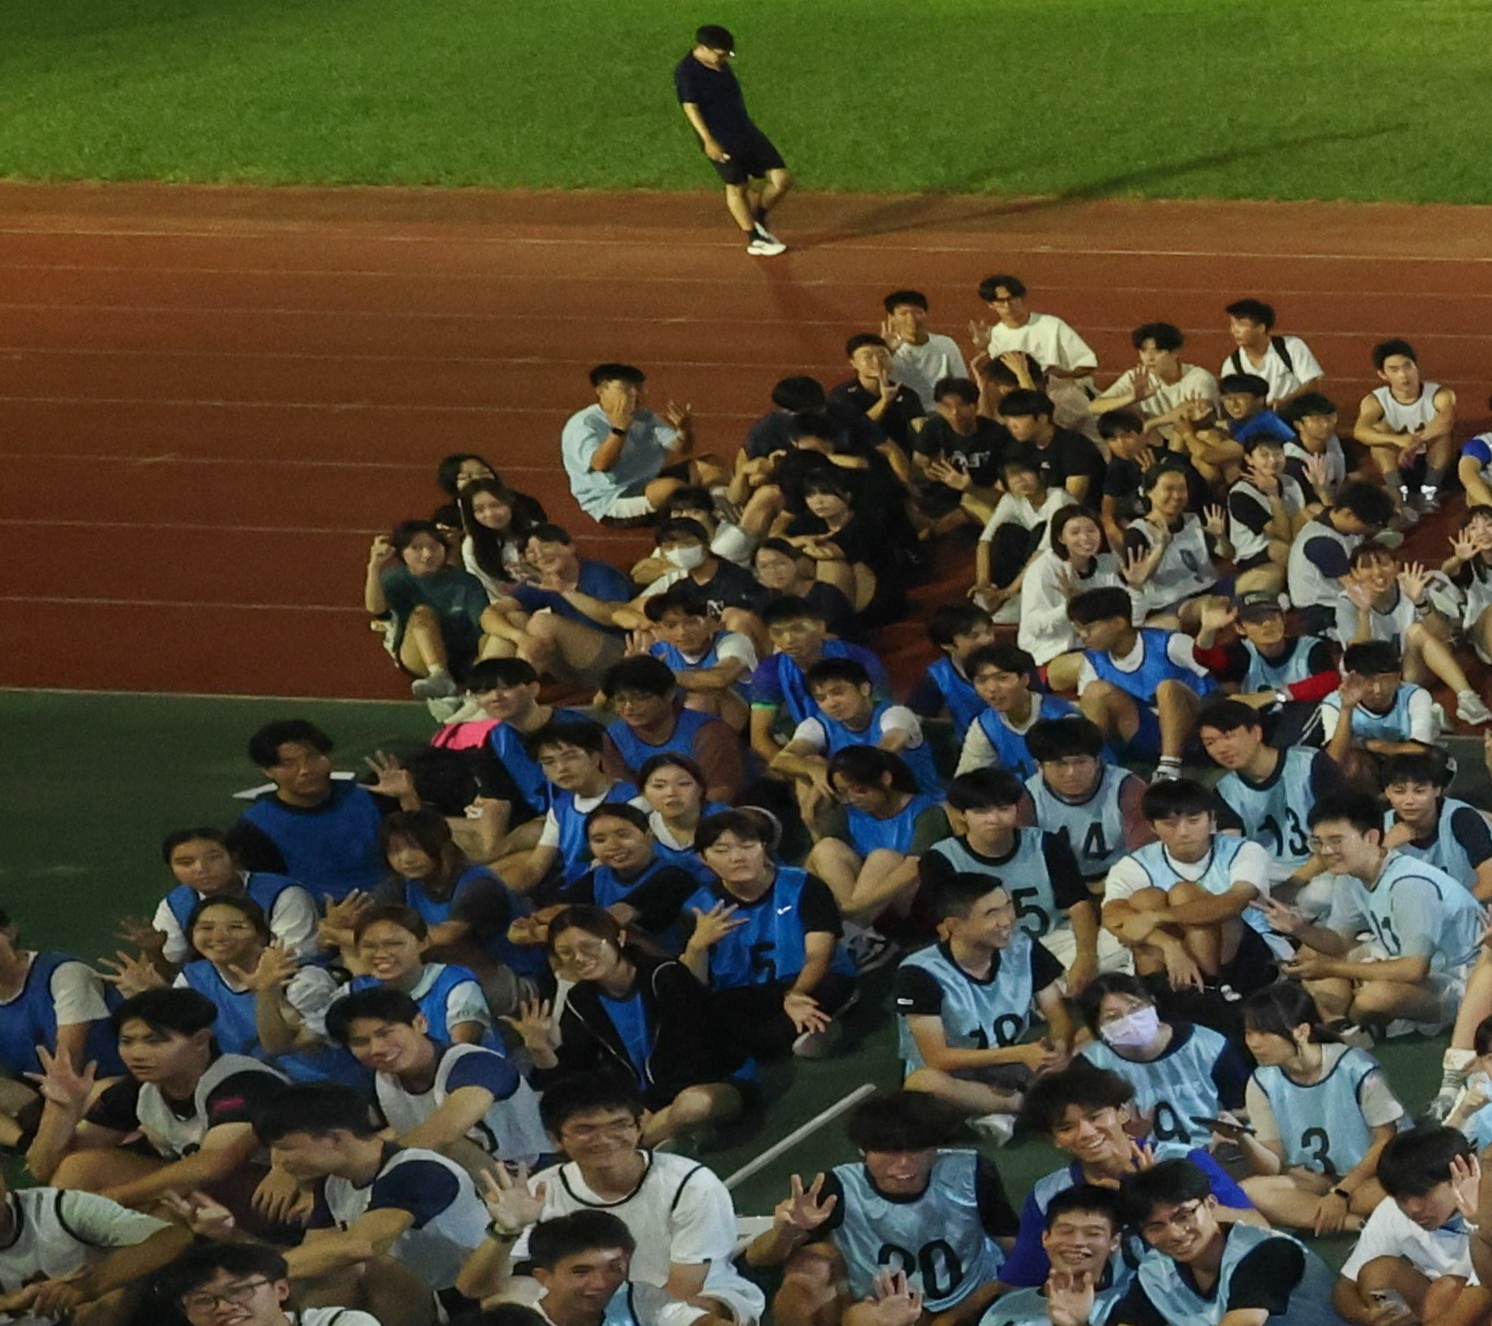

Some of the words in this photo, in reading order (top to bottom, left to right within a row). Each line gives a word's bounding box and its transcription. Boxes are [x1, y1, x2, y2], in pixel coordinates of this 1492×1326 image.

[1259, 807, 1308, 856] 13
[1012, 887, 1049, 939] 5
[1155, 1101, 1192, 1144] 9
[1301, 1127, 1336, 1175] 3
